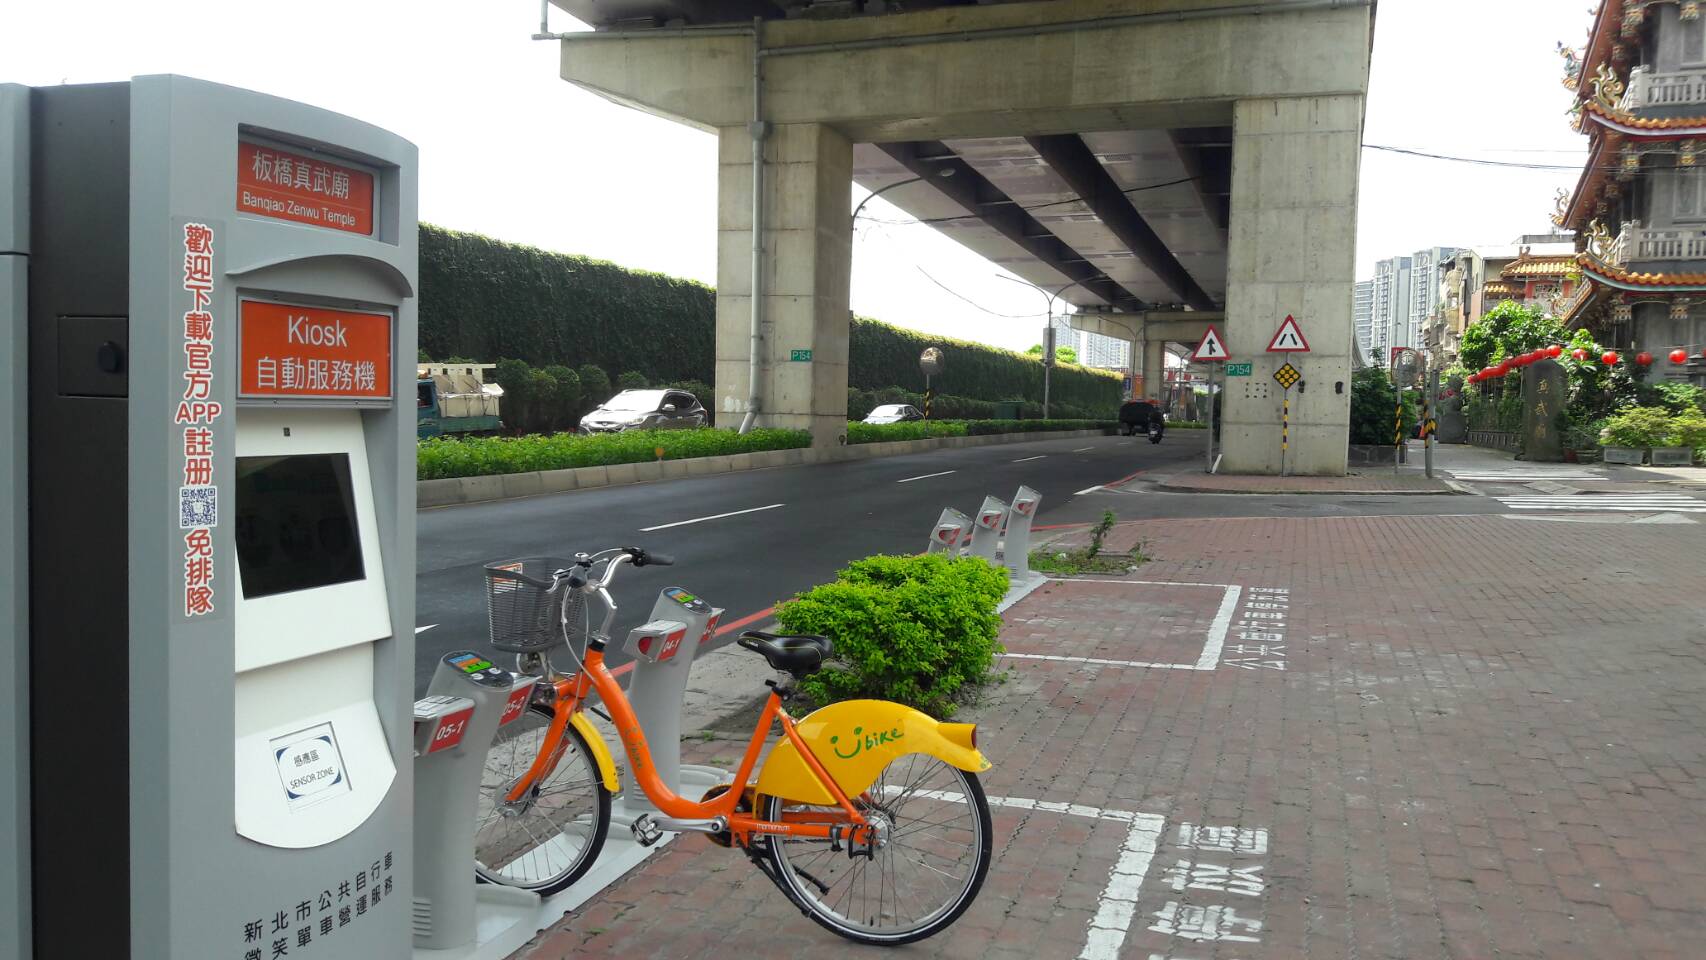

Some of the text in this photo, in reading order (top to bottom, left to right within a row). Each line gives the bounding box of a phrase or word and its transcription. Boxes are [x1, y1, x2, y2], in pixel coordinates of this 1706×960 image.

[252, 150, 350, 199] 板橋真武廟
[242, 191, 356, 227] Banqiao Zenwu Temple
[288, 315, 347, 347] Kiosk
[257, 356, 376, 391] 自動服務機
[184, 528, 214, 616] 免排隊
[436, 719, 465, 741] 05-1
[290, 766, 334, 790] SENSOR ZONE
[244, 851, 393, 943] 新北市公共自行車
